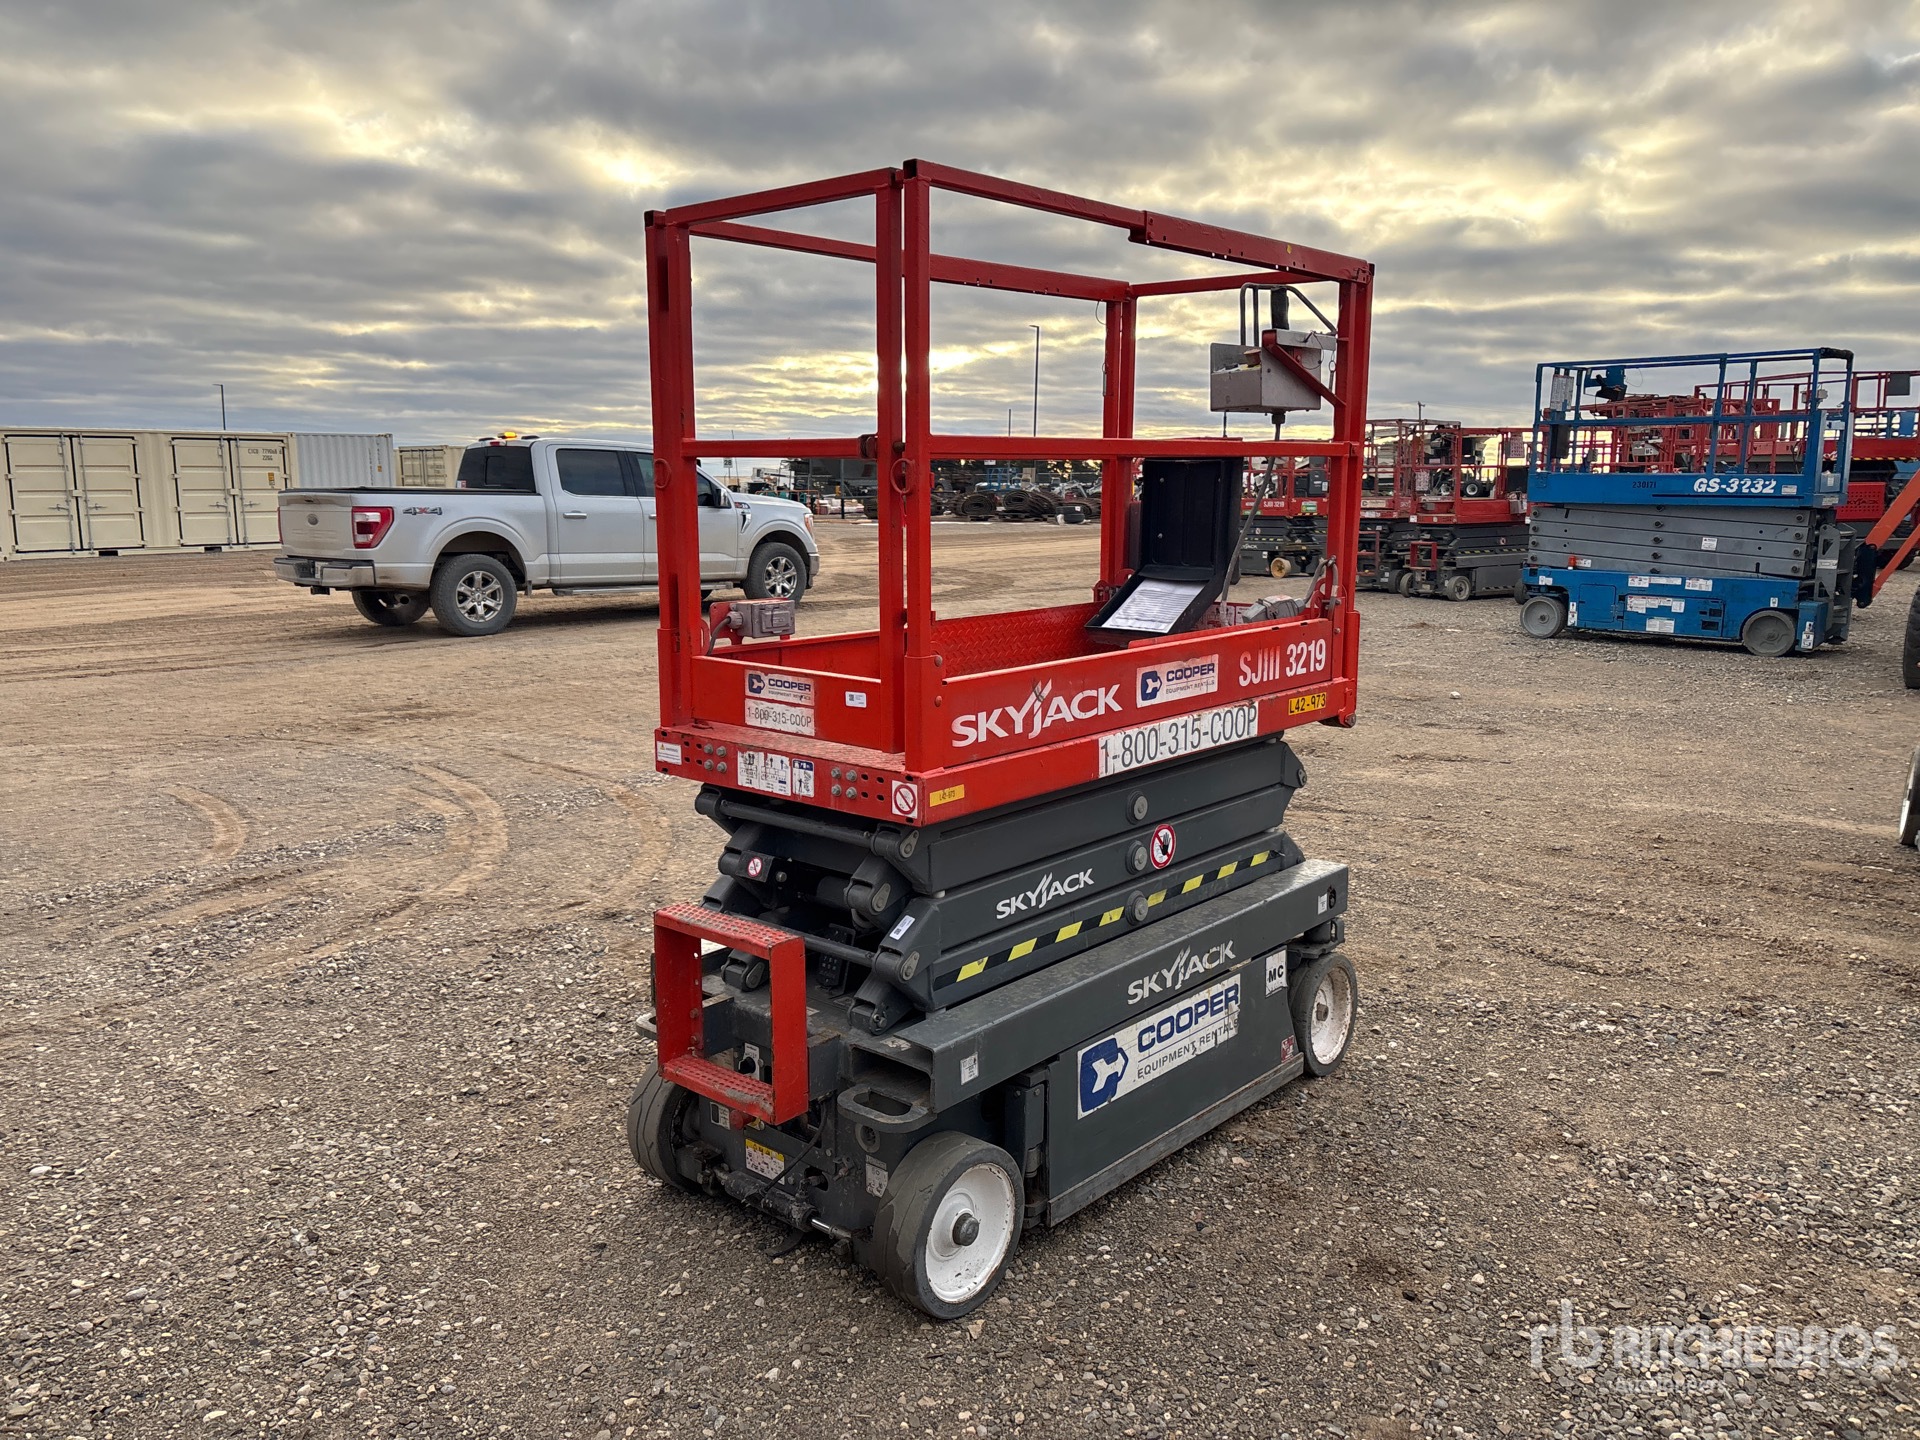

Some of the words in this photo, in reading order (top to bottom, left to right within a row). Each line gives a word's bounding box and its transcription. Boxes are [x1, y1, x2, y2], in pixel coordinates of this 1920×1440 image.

[1632, 481, 1657, 489] 230171
[1693, 477, 1777, 494] GS-3232
[1285, 638, 1327, 678] 3219
[1166, 663, 1215, 682] COOPER
[768, 678, 812, 692] COOPER
[768, 690, 792, 698] EQUIPMENT
[1165, 684, 1193, 694] EQUIPMENT
[951, 678, 1123, 748] SKYJACK
[1289, 693, 1327, 715] L42-973
[747, 706, 812, 727] 1-800-315-COOP
[1100, 704, 1257, 774] 1-800-315-COOP
[996, 868, 1095, 920] SKYJACK
[1127, 940, 1236, 1005] SKYJACK
[1268, 964, 1284, 983] MC
[1137, 983, 1240, 1053] COOPER
[1137, 1041, 1196, 1079] EQUIPMENT
[1199, 1018, 1240, 1047] RENTALS
